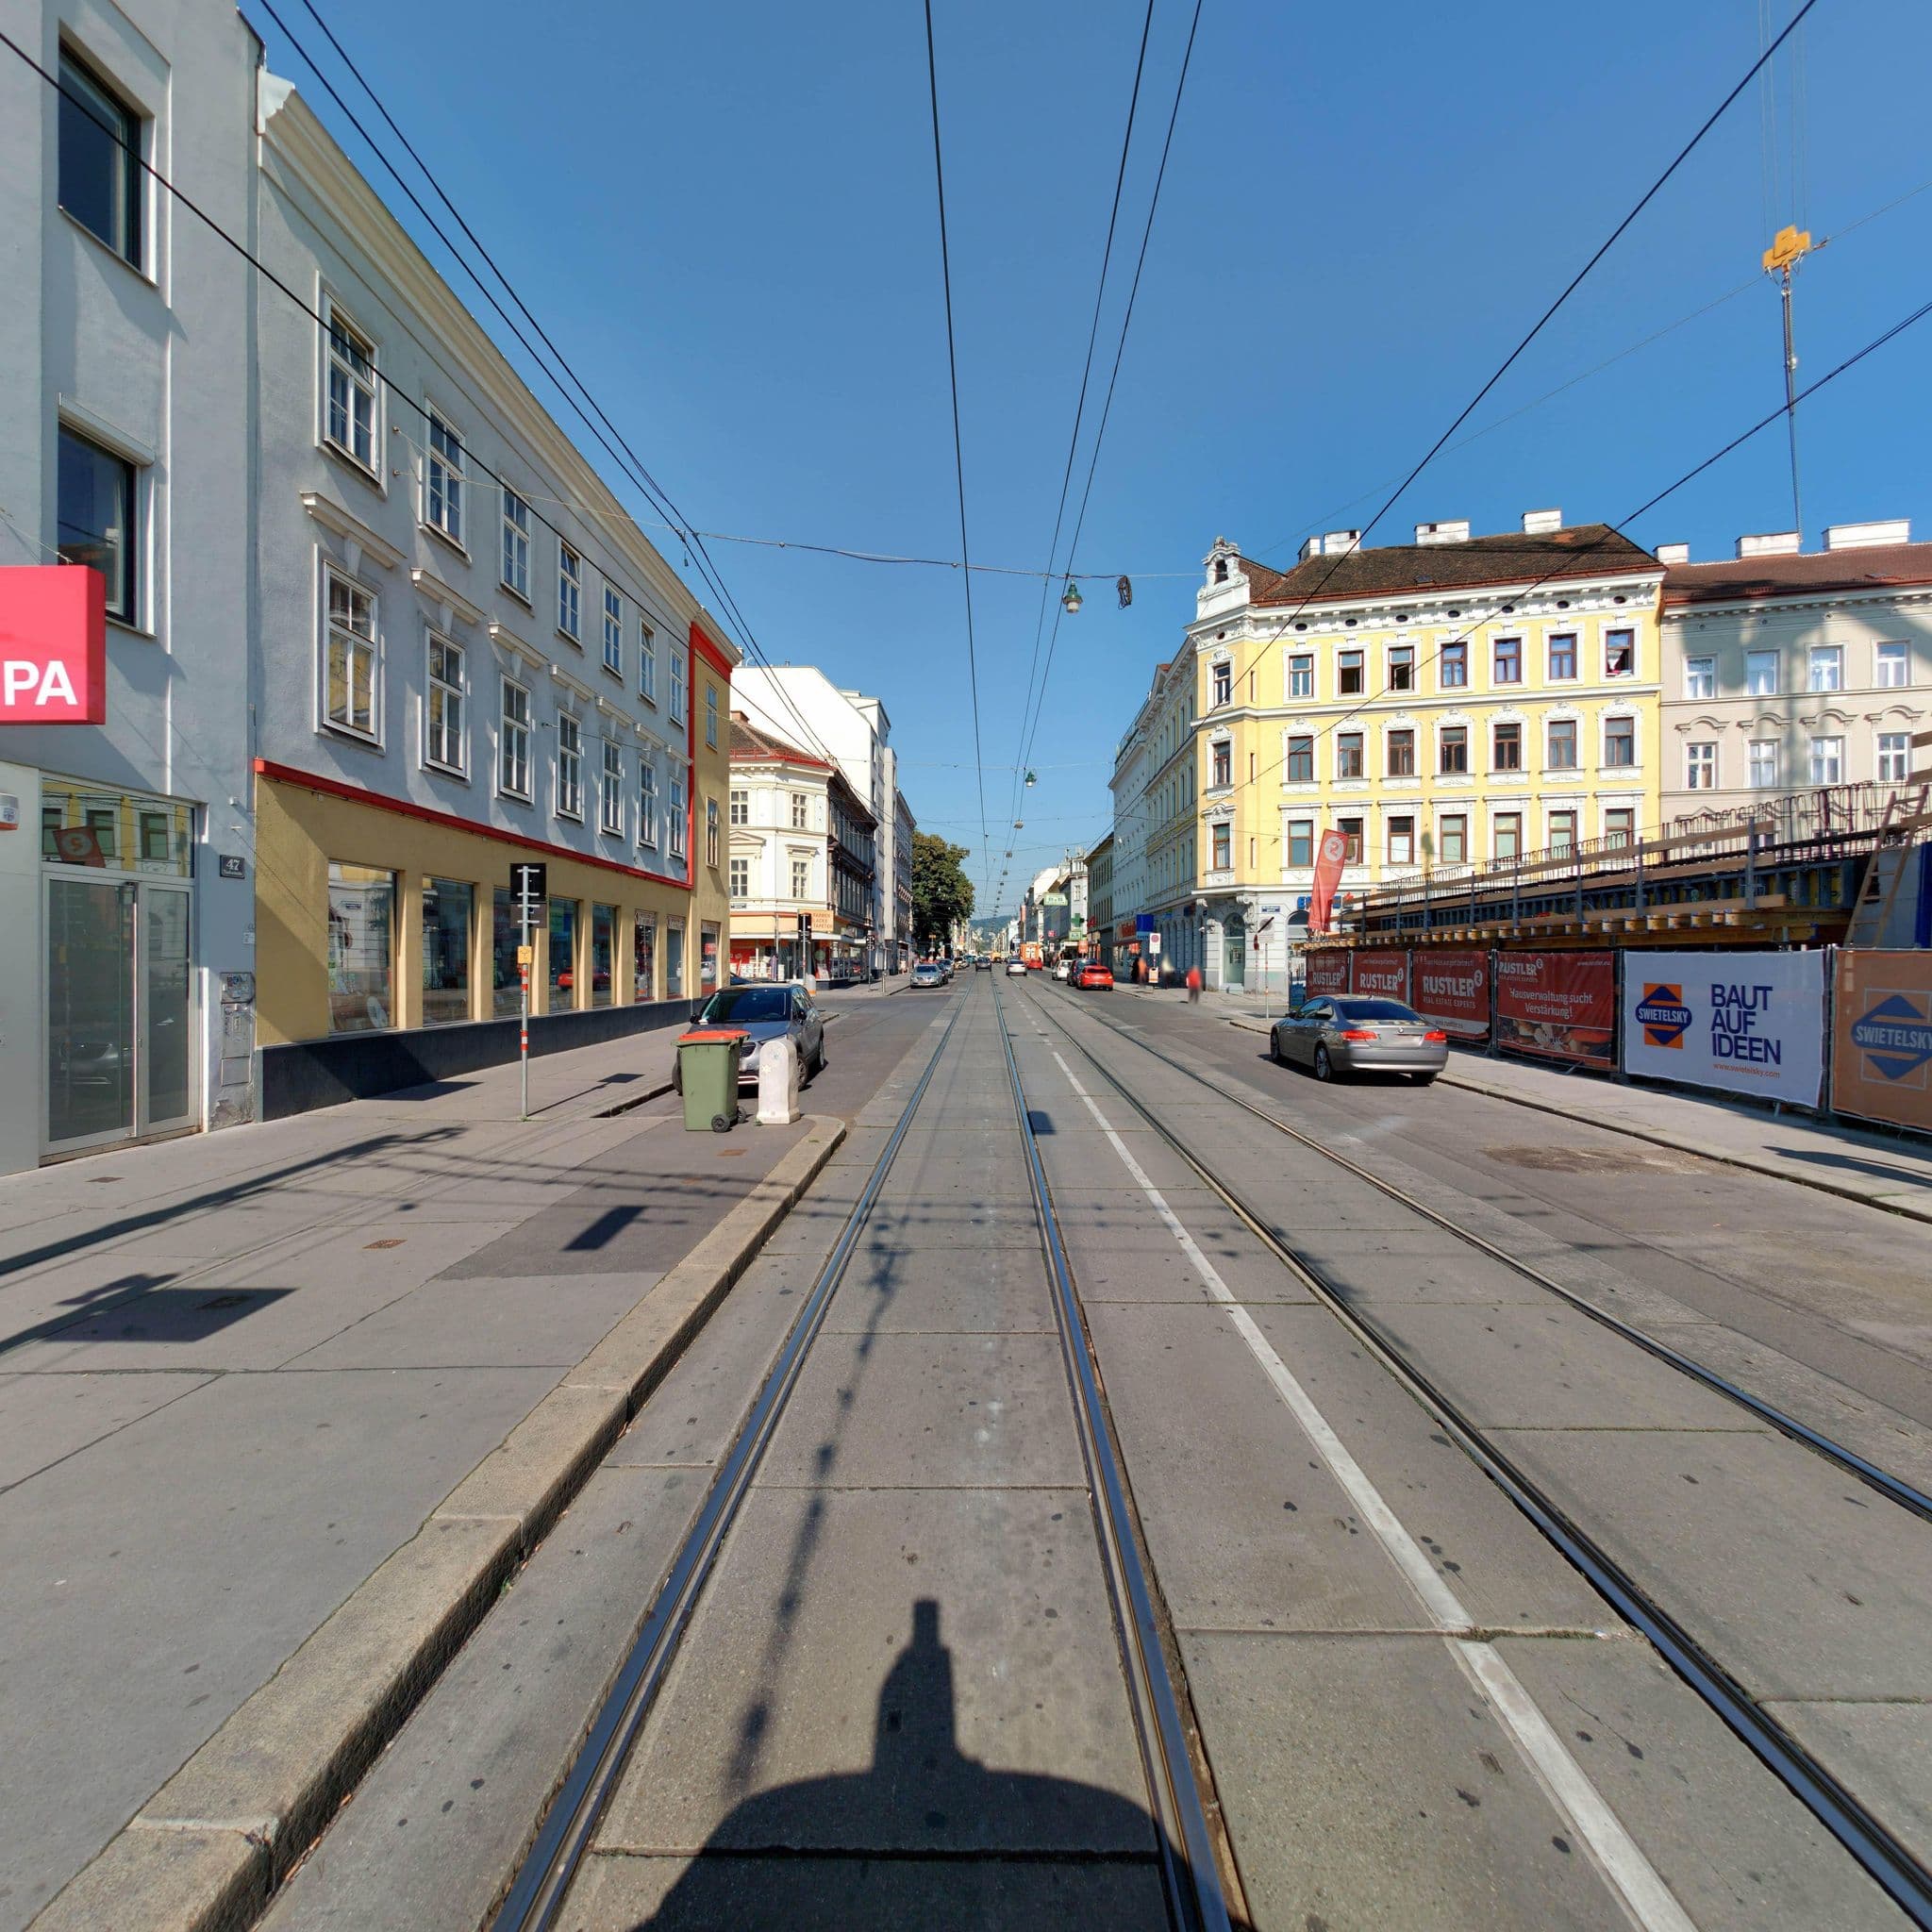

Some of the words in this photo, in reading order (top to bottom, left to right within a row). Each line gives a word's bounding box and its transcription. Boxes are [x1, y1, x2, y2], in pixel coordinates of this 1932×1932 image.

[3, 659, 78, 707] PA
[225, 858, 241, 871] 47
[1312, 972, 1341, 987] RUSTLER
[1359, 973, 1398, 991] RUSTLER
[1423, 975, 1475, 998] RUSTLER
[1509, 987, 1568, 1005] Hausverwaltung
[1569, 992, 1593, 1005] sucht
[1710, 983, 1774, 1010] BAUT
[1524, 1002, 1573, 1020] Verstärkung!
[1639, 1008, 1689, 1024] SWIETELSKY
[1710, 1009, 1757, 1035] AUF
[1856, 1025, 1932, 1050] SWIETELSKY
[1711, 1033, 1781, 1065] IDEEN
[1713, 1062, 1781, 1079] www.swietelsky.com
